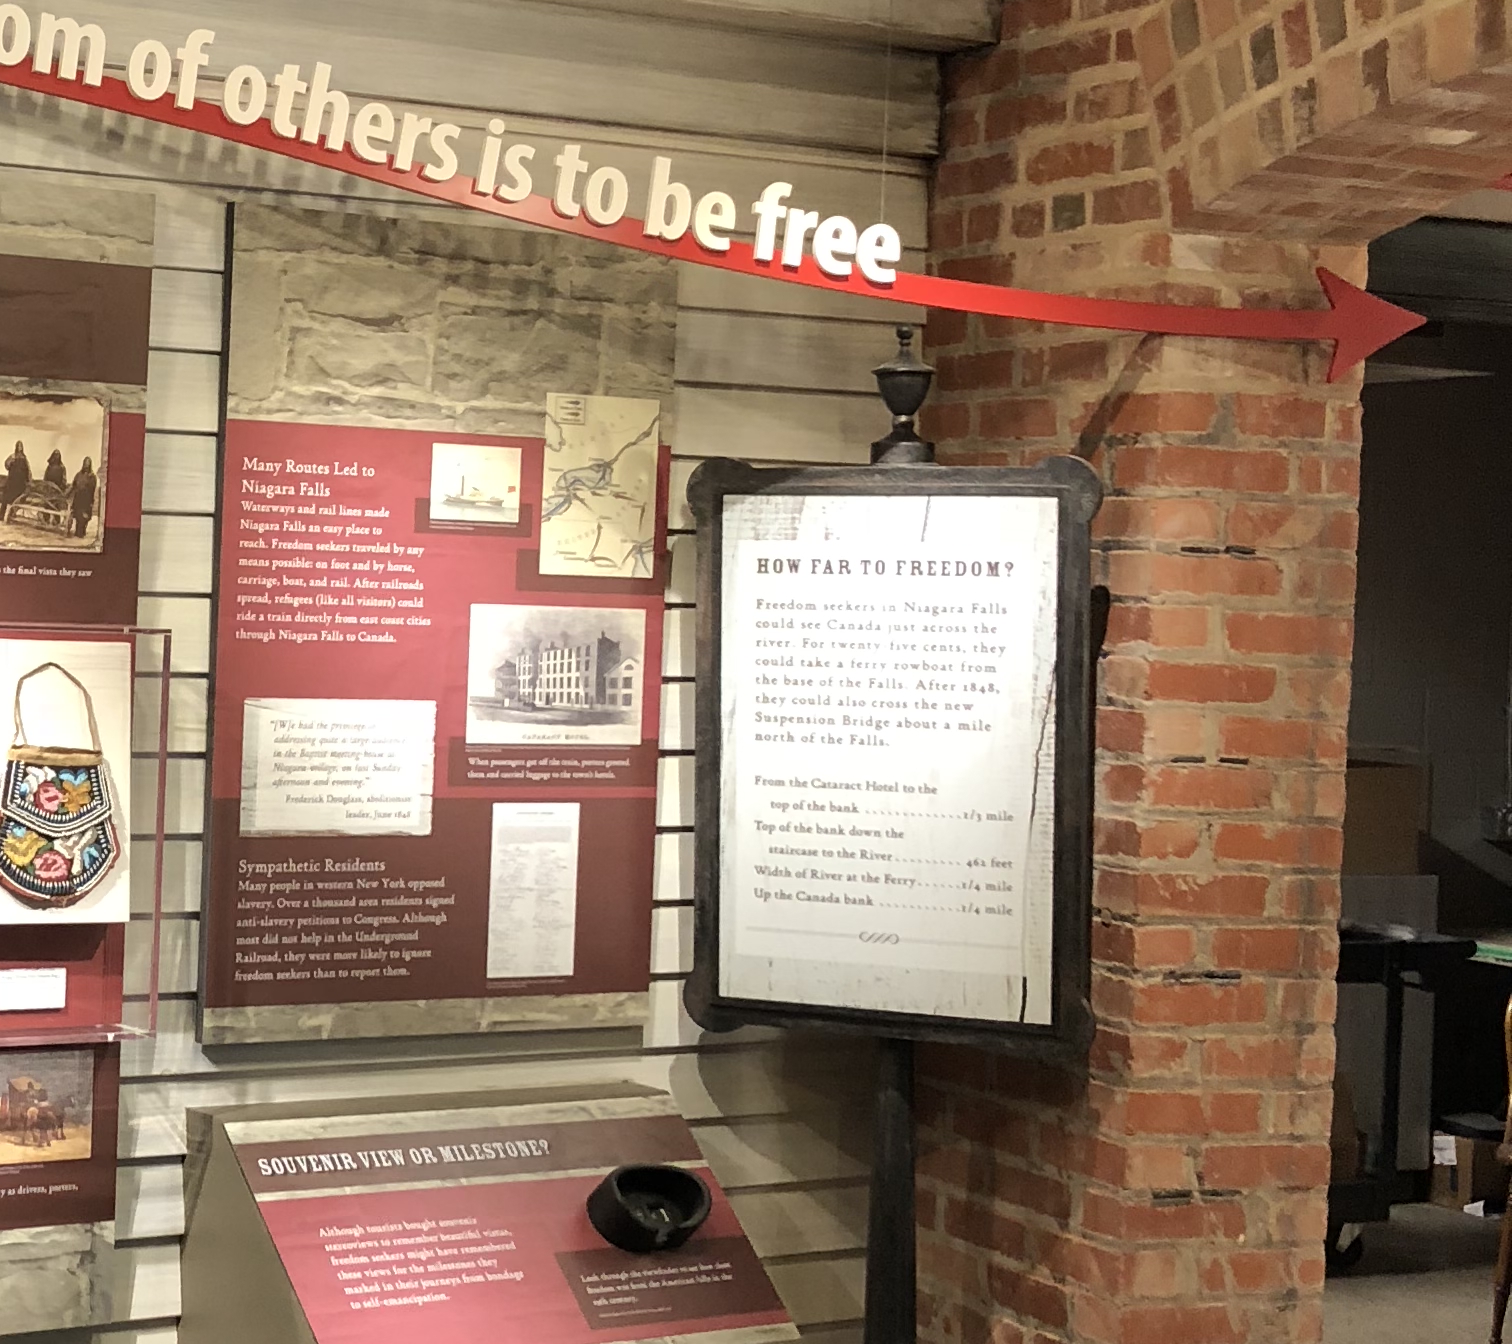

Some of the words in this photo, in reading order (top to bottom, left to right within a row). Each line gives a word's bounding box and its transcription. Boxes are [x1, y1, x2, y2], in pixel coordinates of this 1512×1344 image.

[126, 28, 216, 111] of
[224, 61, 462, 184] others
[479, 117, 534, 203] is
[553, 142, 630, 227] to
[643, 157, 735, 252] be
[753, 181, 902, 285] free
[242, 457, 281, 475] Many
[285, 459, 329, 474] Routes
[333, 462, 357, 475] Led
[362, 467, 374, 476] to
[241, 480, 294, 498] Niagara
[299, 482, 330, 496] Falls
[757, 558, 800, 573] HOW
[811, 559, 850, 574] FAR
[860, 560, 885, 574] TO
[896, 560, 1013, 576] FREEDOM?
[236, 629, 275, 642] through
[279, 630, 317, 643] Niagara
[321, 630, 343, 641] Falls
[358, 631, 396, 642] Canada.
[755, 693, 785, 706] they
[791, 695, 830, 705] could
[837, 696, 865, 706] also
[914, 698, 937, 709] the
[755, 712, 835, 726] Suspension
[842, 715, 889, 730] Bridge
[896, 717, 936, 728] about
[958, 720, 991, 731] mile
[755, 731, 794, 742] north
[800, 732, 815, 743] of
[820, 733, 842, 744] the
[850, 734, 889, 746] Falls.
[754, 775, 785, 786] From
[789, 777, 807, 787] the
[810, 778, 861, 790] Cataract
[865, 781, 898, 792] Hotel
[902, 785, 915, 793] to
[918, 783, 937, 794] the
[238, 859, 319, 877] Sympathetic
[324, 858, 385, 871] Residents
[258, 1153, 357, 1174] SOUVENIR
[357, 1150, 404, 1167] VIEW
[409, 1147, 438, 1163] OR
[438, 1140, 549, 1161] MILESTONE?
